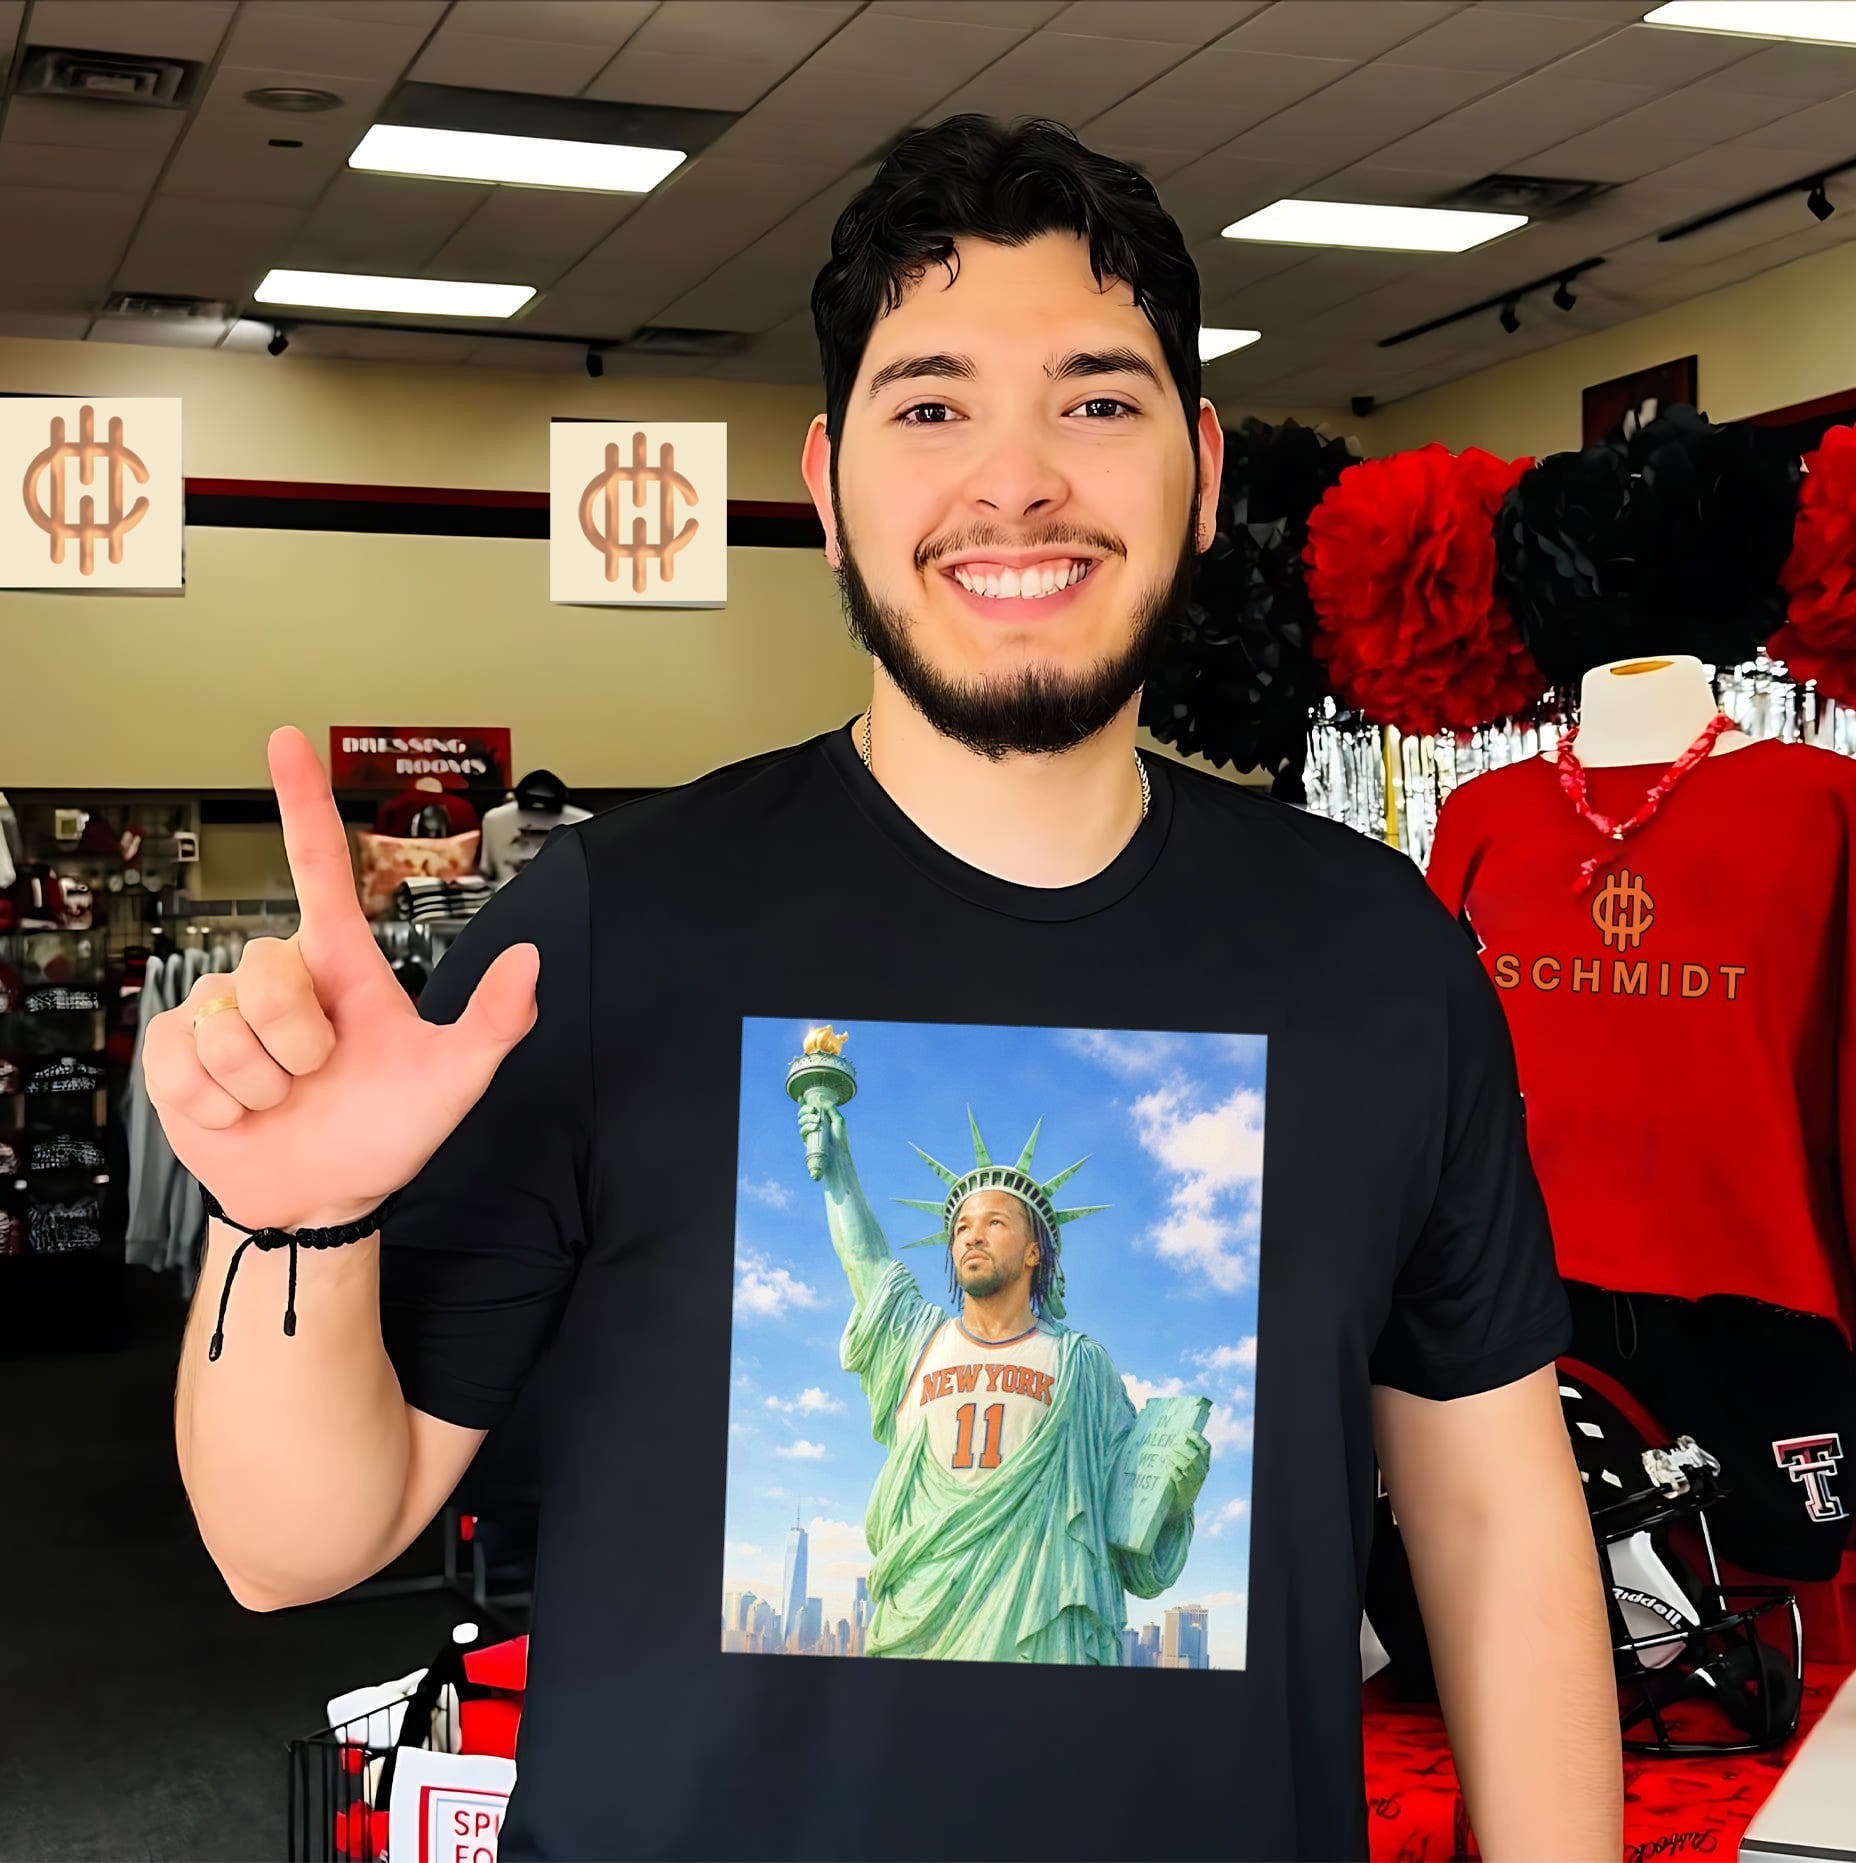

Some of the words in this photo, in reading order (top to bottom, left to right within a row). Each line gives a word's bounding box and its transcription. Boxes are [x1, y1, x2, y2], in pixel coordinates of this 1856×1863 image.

[396, 758, 487, 775] ROOMS
[1494, 953, 1747, 1000] SCHMIDT
[919, 1364, 984, 1407] NEW
[984, 1363, 1056, 1406] YORK
[951, 1402, 1005, 1469] 11
